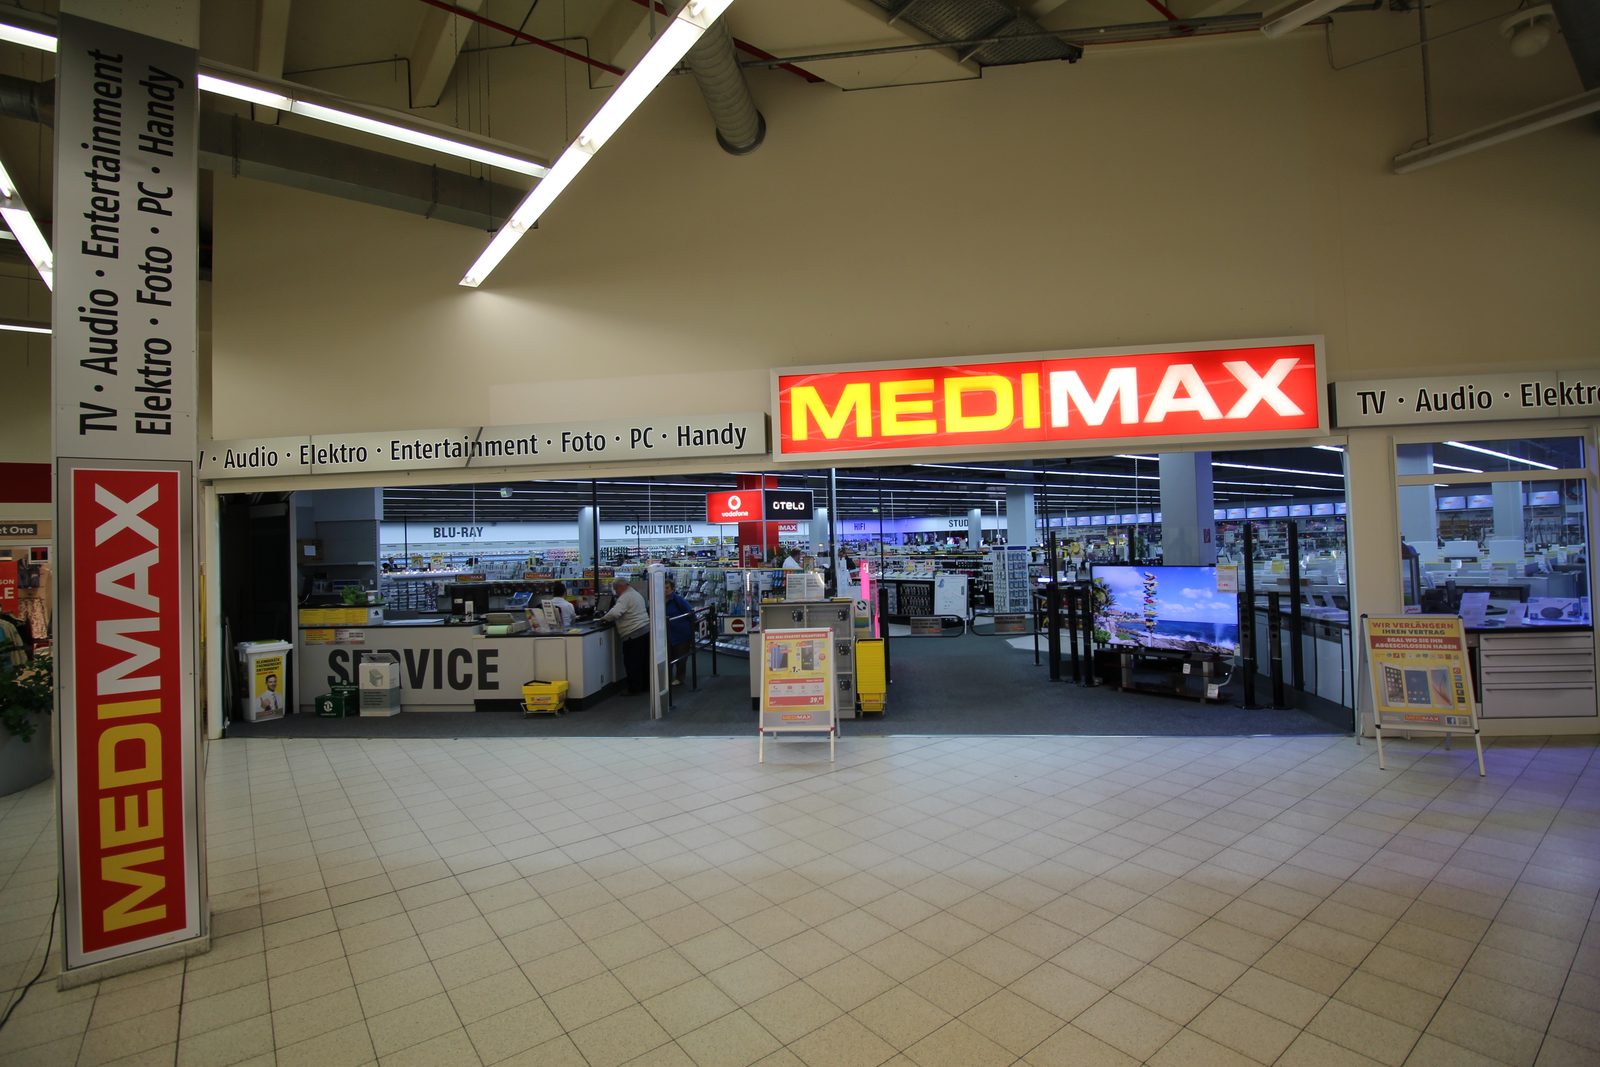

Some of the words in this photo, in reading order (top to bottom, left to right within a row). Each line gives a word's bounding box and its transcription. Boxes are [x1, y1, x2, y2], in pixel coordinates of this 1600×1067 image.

[138, 66, 184, 157] Handy
[82, 50, 123, 259] Entertainment
[138, 182, 172, 216] PC
[136, 246, 172, 306] Foto
[78, 288, 118, 376] Audio
[135, 338, 172, 434] Elektro
[790, 358, 1304, 441] MEDIMAX
[1356, 390, 1386, 415] TV
[1415, 384, 1492, 413] Audio
[80, 402, 118, 434] TV
[224, 446, 278, 469] Audio
[300, 443, 368, 465] Elektro
[391, 434, 538, 460] Entertainment
[561, 431, 606, 453] Foto
[630, 427, 654, 449] PC
[677, 422, 746, 450] Handy
[10, 526, 34, 534] One
[433, 526, 484, 538] BLU-RAY
[328, 648, 499, 690] SEVICE
[94, 482, 166, 932] MEDIMAX
